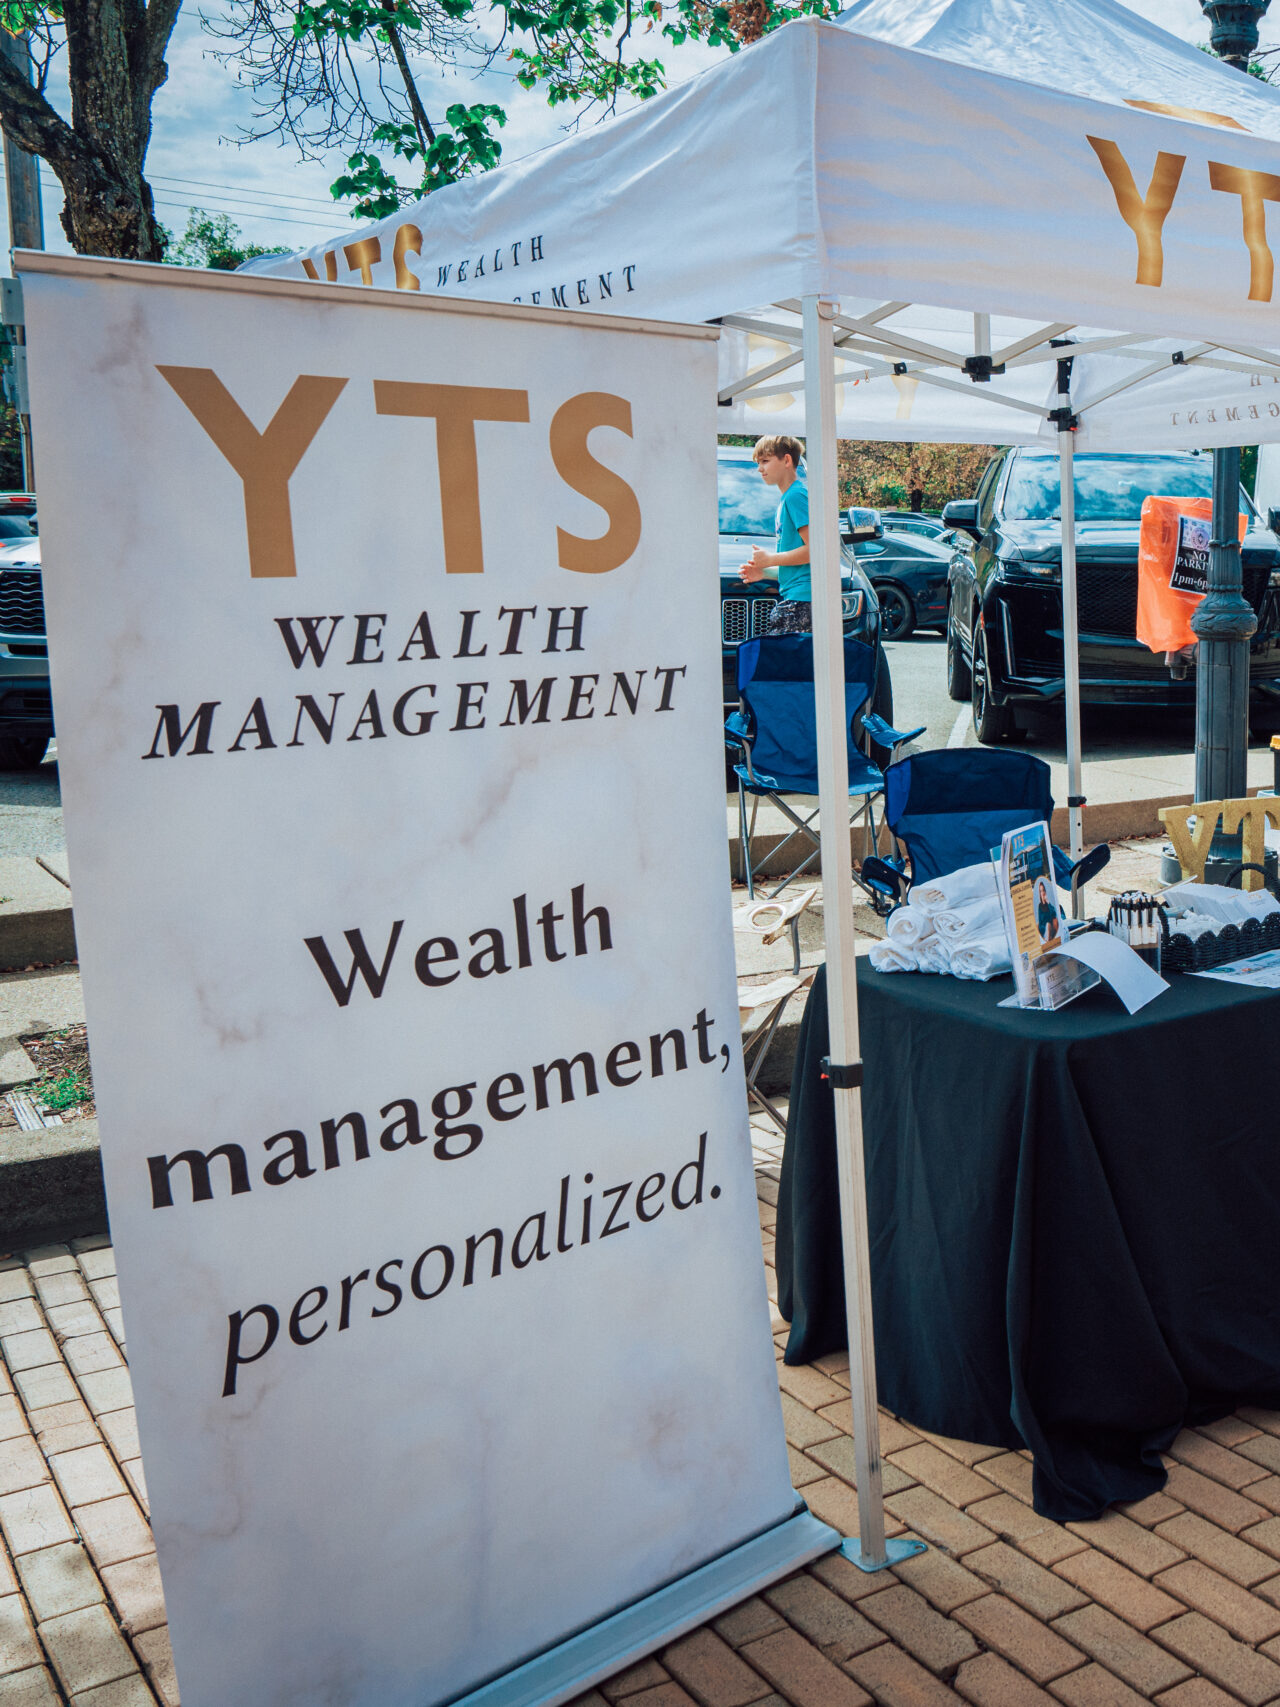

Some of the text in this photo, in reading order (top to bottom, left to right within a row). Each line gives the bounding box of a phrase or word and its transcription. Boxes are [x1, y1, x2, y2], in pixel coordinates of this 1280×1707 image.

[301, 223, 424, 291] TS
[436, 235, 544, 288] WEALTH
[156, 365, 641, 578] YTS
[1174, 572, 1208, 590] 1pm-6p
[1177, 556, 1208, 571] PARKI
[1192, 550, 1207, 562] NO
[273, 605, 589, 670] WEALTH
[141, 664, 688, 760] MANAGEMENT
[303, 883, 613, 1008] Wealth
[146, 1007, 731, 1211] management,
[221, 1131, 723, 1398] personalized.
